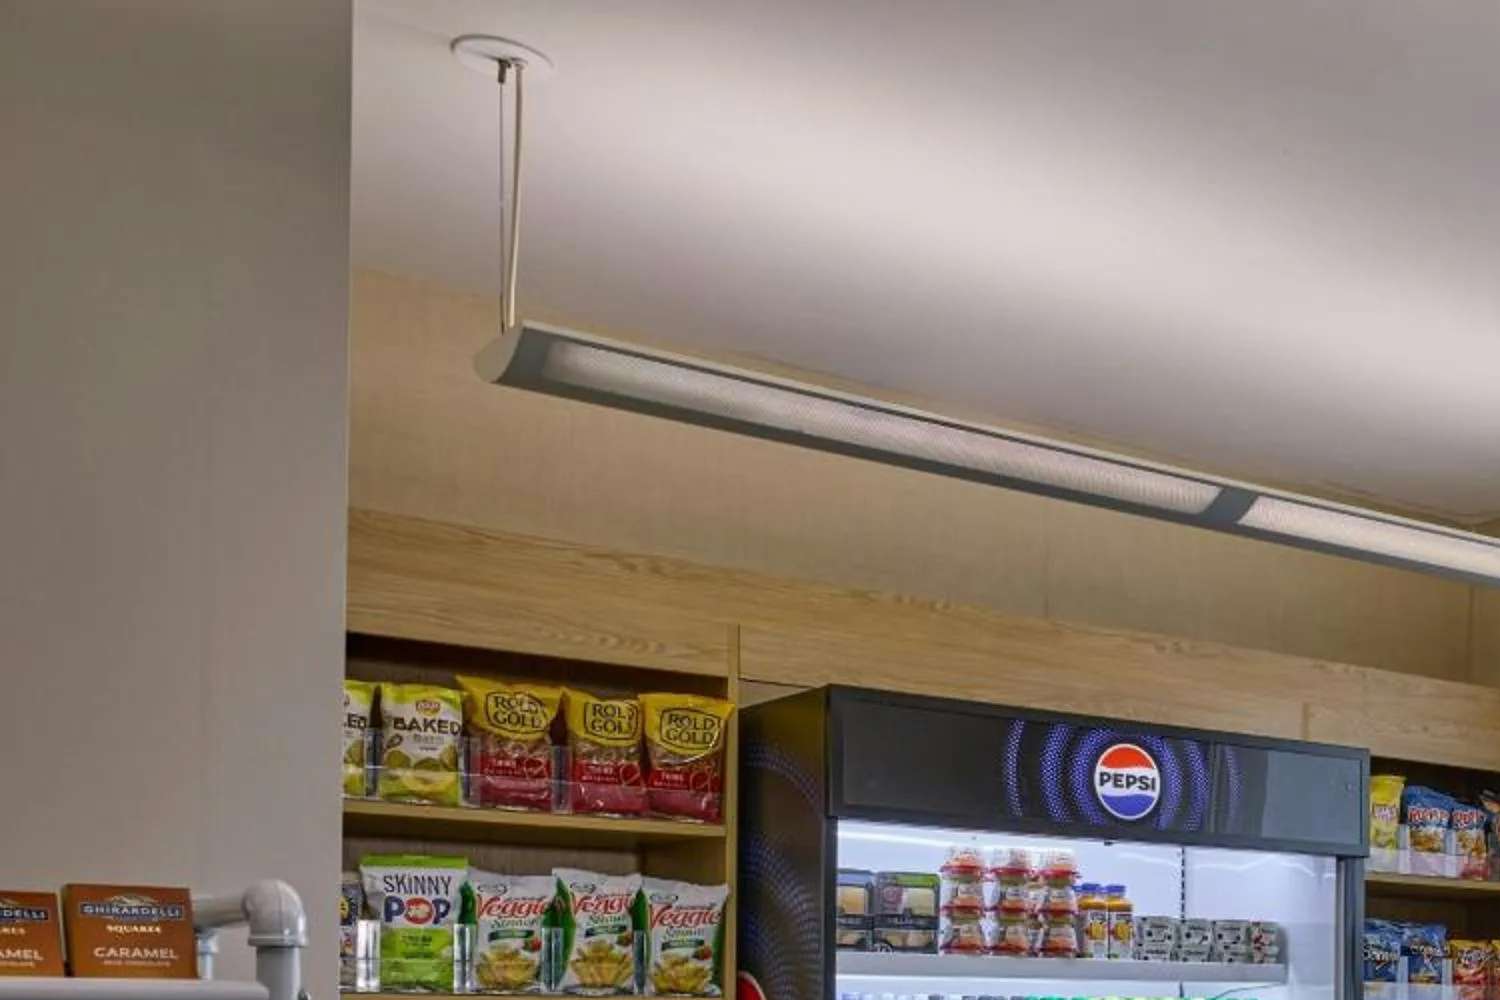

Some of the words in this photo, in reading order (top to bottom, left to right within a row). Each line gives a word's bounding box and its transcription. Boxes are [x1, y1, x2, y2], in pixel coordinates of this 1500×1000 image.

[494, 695, 540, 714] ROLD
[393, 716, 462, 735] BAKED
[493, 711, 544, 730] GOLD
[668, 713, 715, 731] ROLD
[666, 728, 714, 746] GOLD
[1100, 771, 1156, 792] PEPSI
[83, 904, 182, 918] GHIRARDELLI
[384, 896, 451, 925] POP
[477, 895, 546, 918] Veggi
[106, 925, 162, 935] SQUARES
[94, 946, 178, 960] CARAMEL
